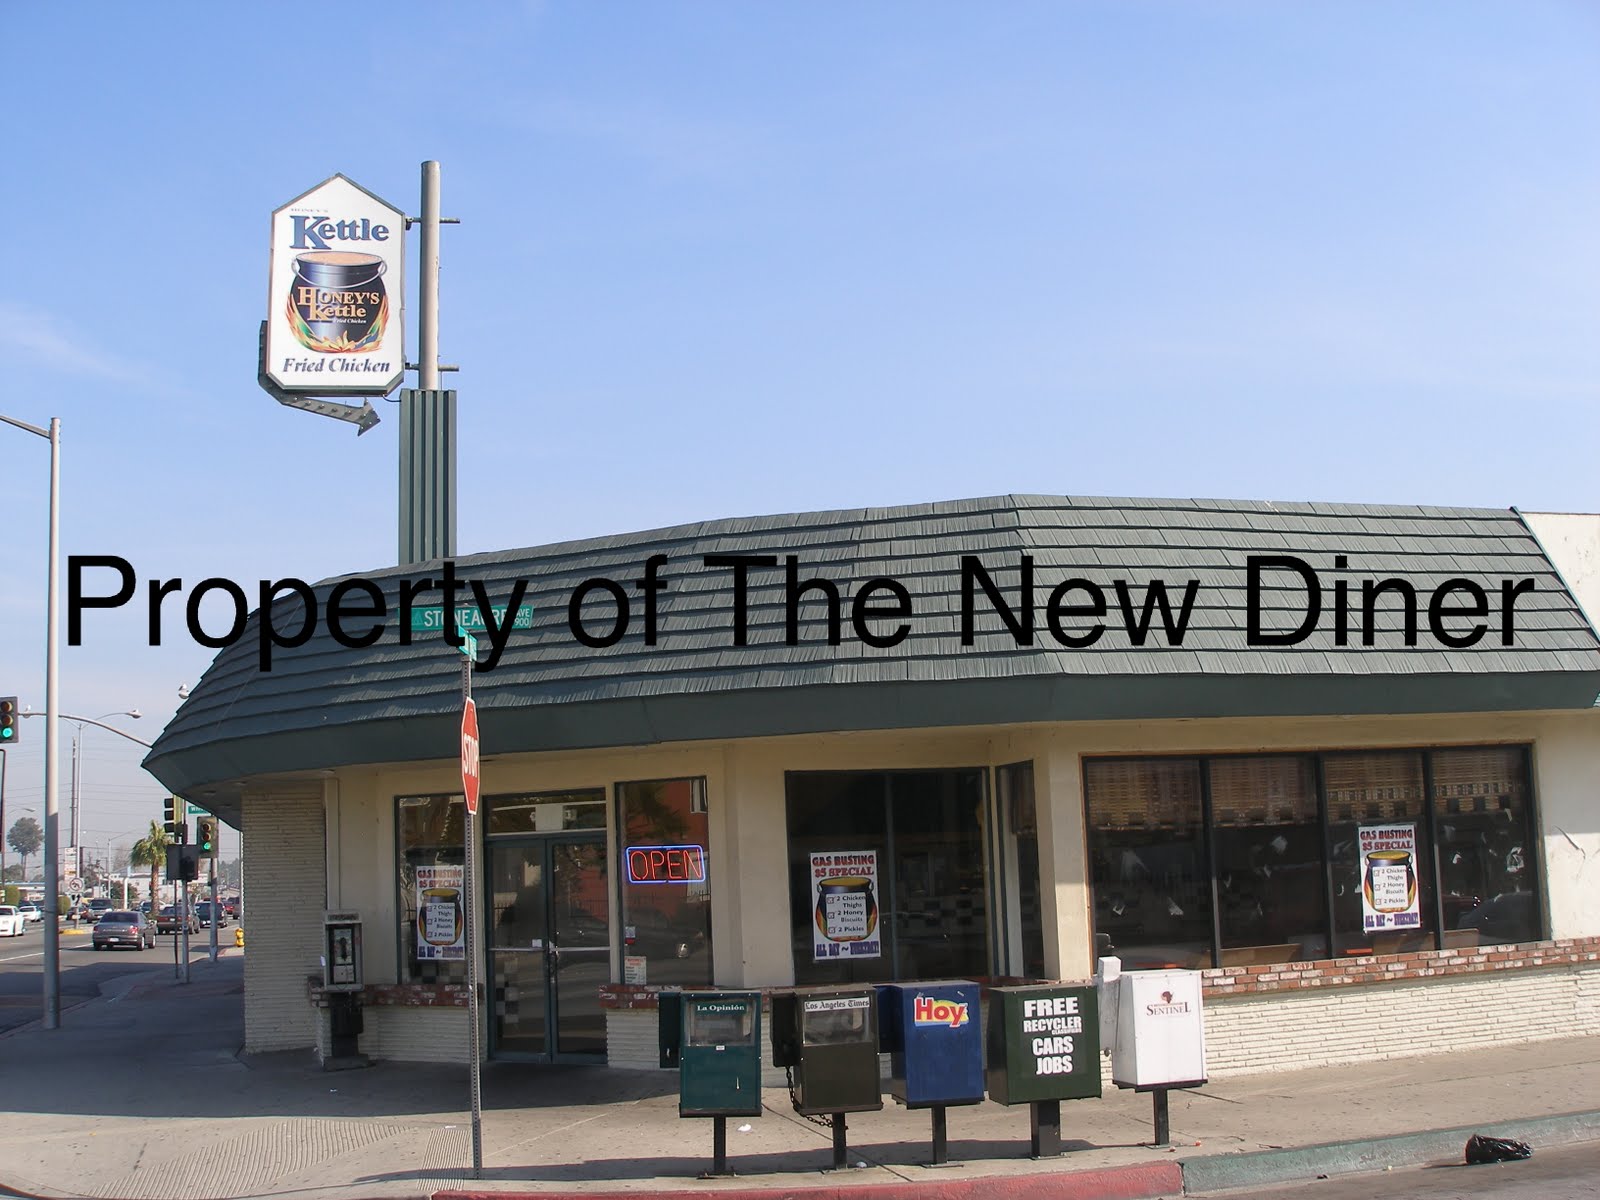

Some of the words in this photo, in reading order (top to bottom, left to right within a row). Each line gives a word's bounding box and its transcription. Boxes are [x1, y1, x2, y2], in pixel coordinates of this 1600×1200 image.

[290, 215, 389, 250] Kettle
[297, 286, 380, 305] HONEY'S
[307, 304, 367, 322] Kettle
[282, 357, 326, 373] Fried
[328, 357, 390, 373] Chicken
[424, 609, 509, 627] STNEAR
[463, 732, 479, 778] STOP
[1360, 830, 1376, 840] GAS
[1378, 829, 1413, 840] BUSTING
[1374, 840, 1413, 850] SPECIAL
[631, 849, 702, 879] OPEN
[812, 856, 832, 867] GAS
[834, 855, 875, 866] BUSTING
[829, 866, 874, 877] SPECIAL
[709, 1004, 745, 1012] Opinión
[820, 1001, 846, 1010] Angeles
[848, 999, 870, 1008] Times
[915, 998, 966, 1026] Hoy
[1024, 997, 1079, 1018] FREE
[1146, 1002, 1191, 1016] SENTINEL
[1023, 1016, 1082, 1033] RECYCLER
[1032, 1035, 1074, 1056] CARS
[1036, 1055, 1073, 1075] JOBS
